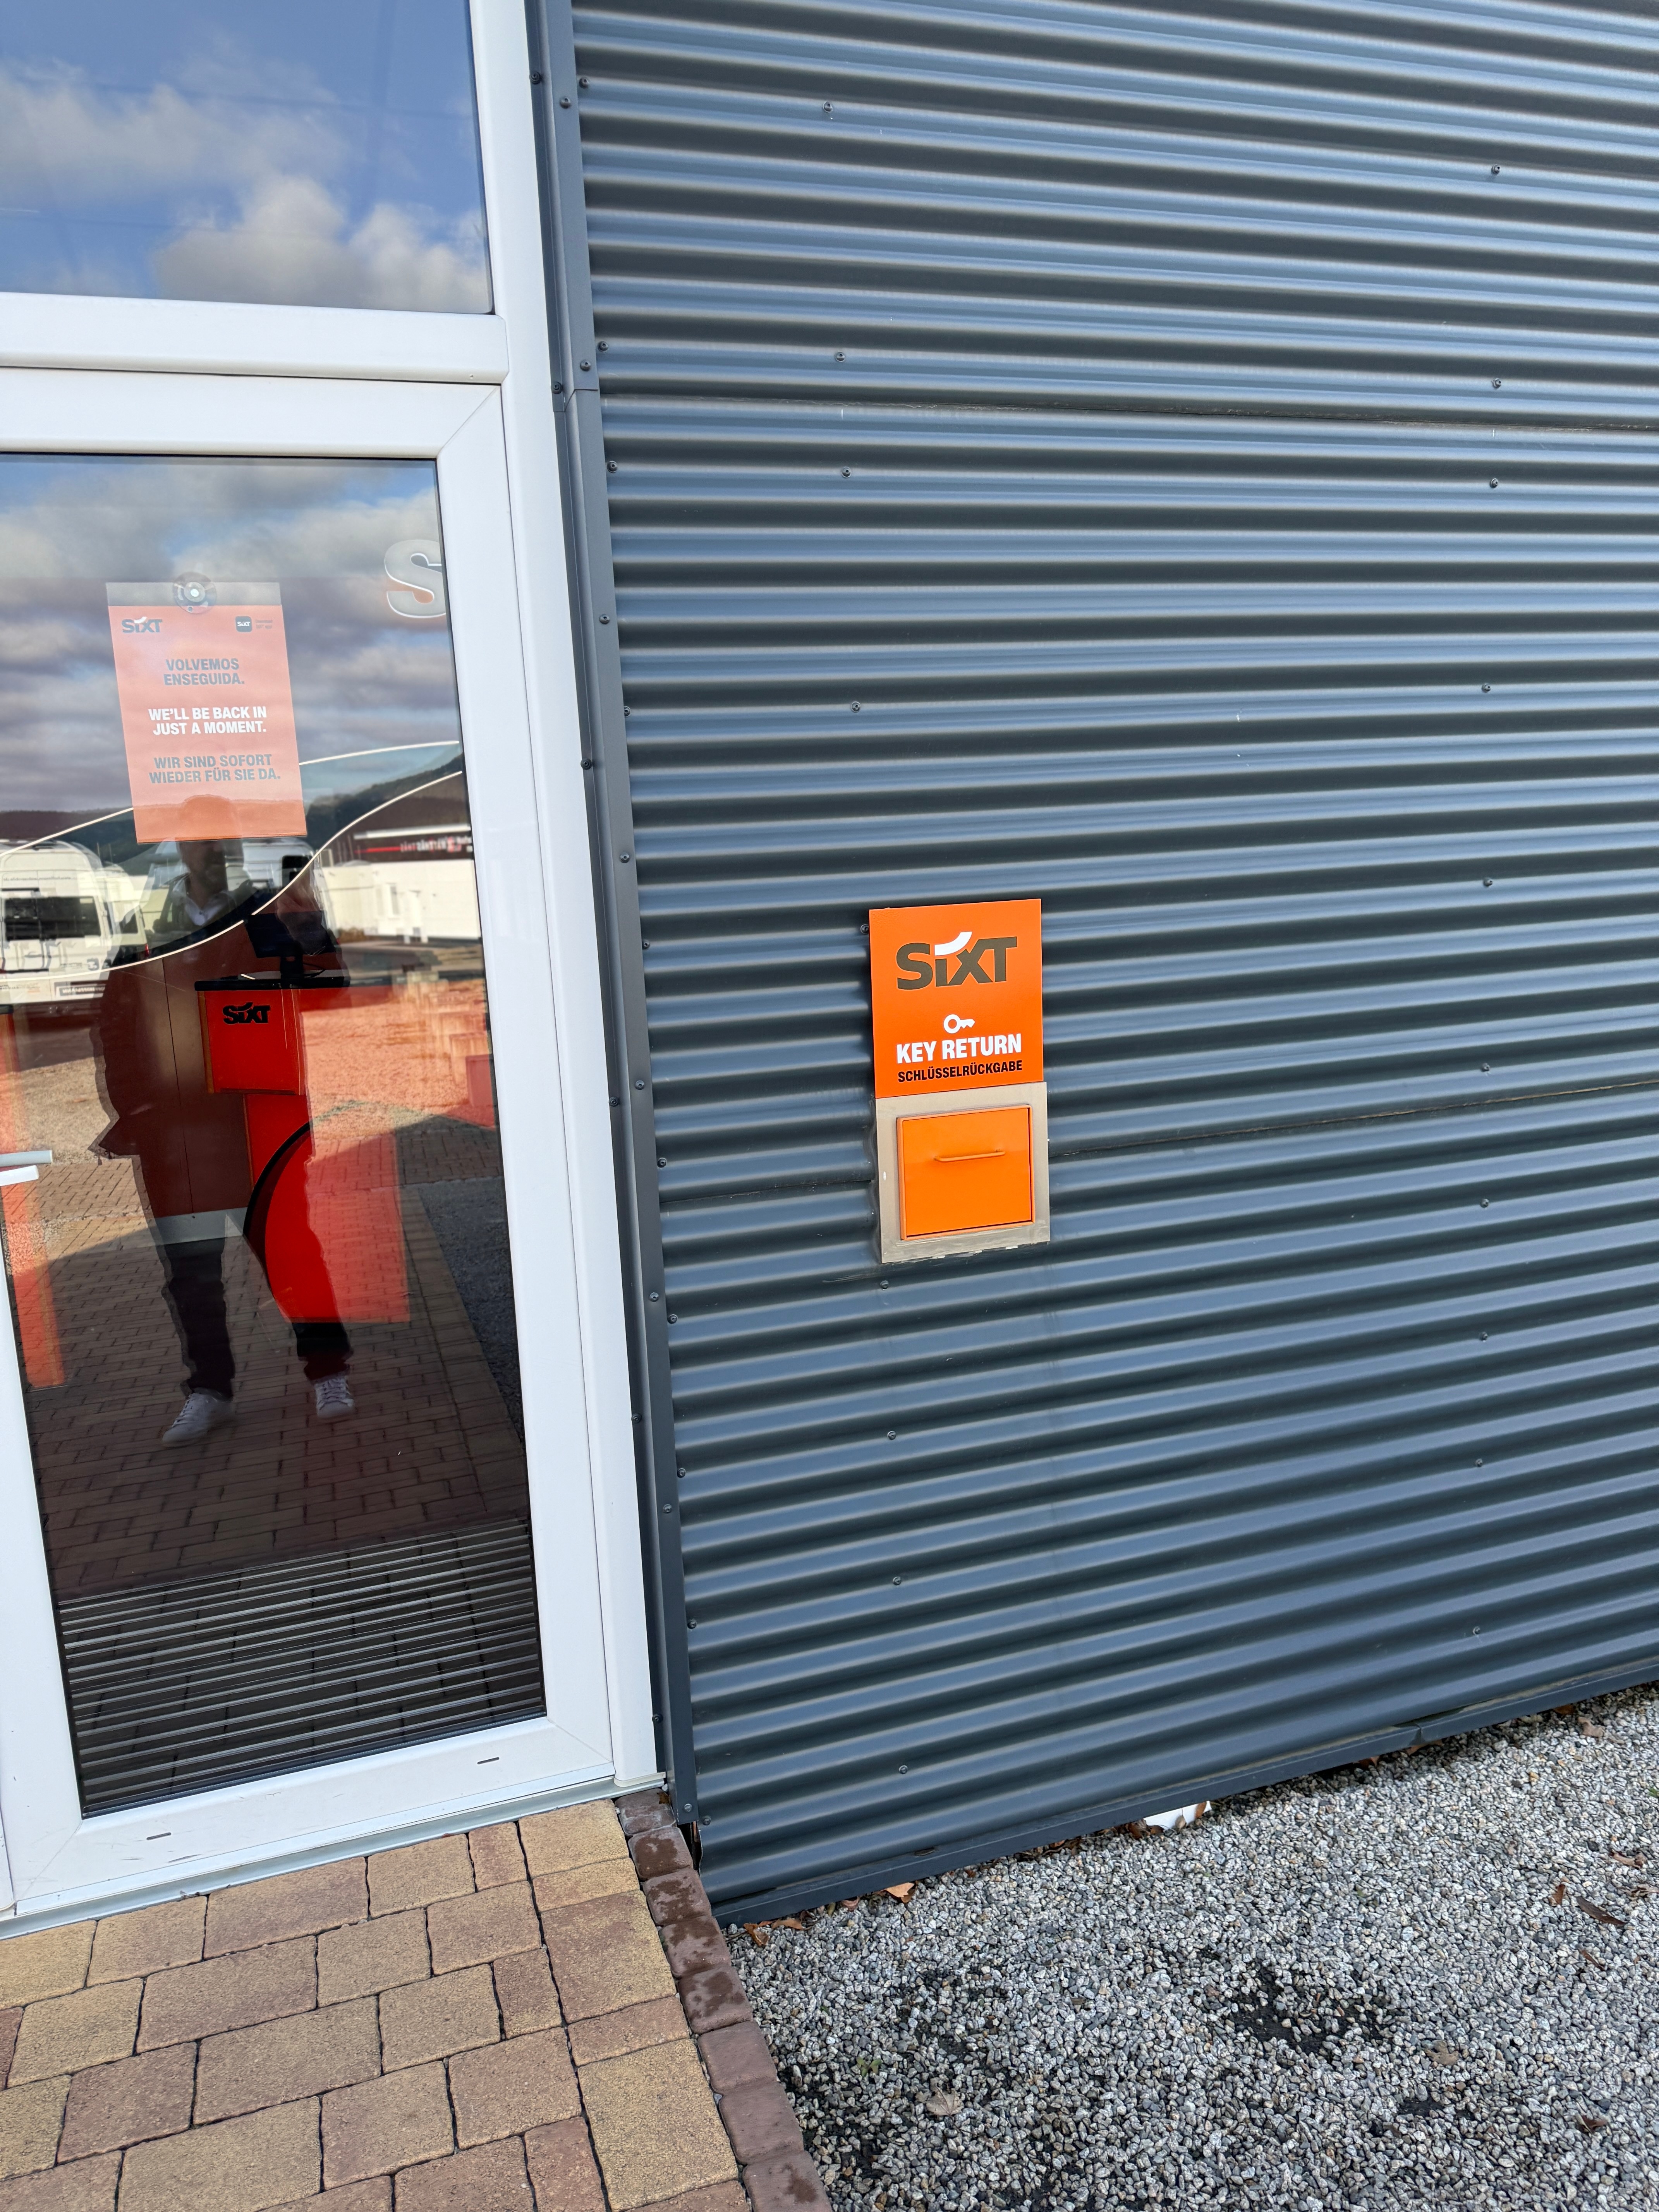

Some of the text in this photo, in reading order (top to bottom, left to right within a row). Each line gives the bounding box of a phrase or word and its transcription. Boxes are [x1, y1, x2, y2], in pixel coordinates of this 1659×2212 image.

[165, 658, 239, 671] VOLVEMOS
[164, 673, 245, 685] ENSEGUIDA.
[148, 706, 267, 721] WE'LL BE BACK IN
[153, 721, 267, 735] JUST A MOMENT.
[153, 754, 272, 769] WIR SIND SOFORT
[149, 767, 281, 783] WIEDER FÜR SIE DA.
[896, 1034, 1022, 1064] KEY RETURN
[898, 1060, 1023, 1082] SCHLÜSSELRÜCKGABE
